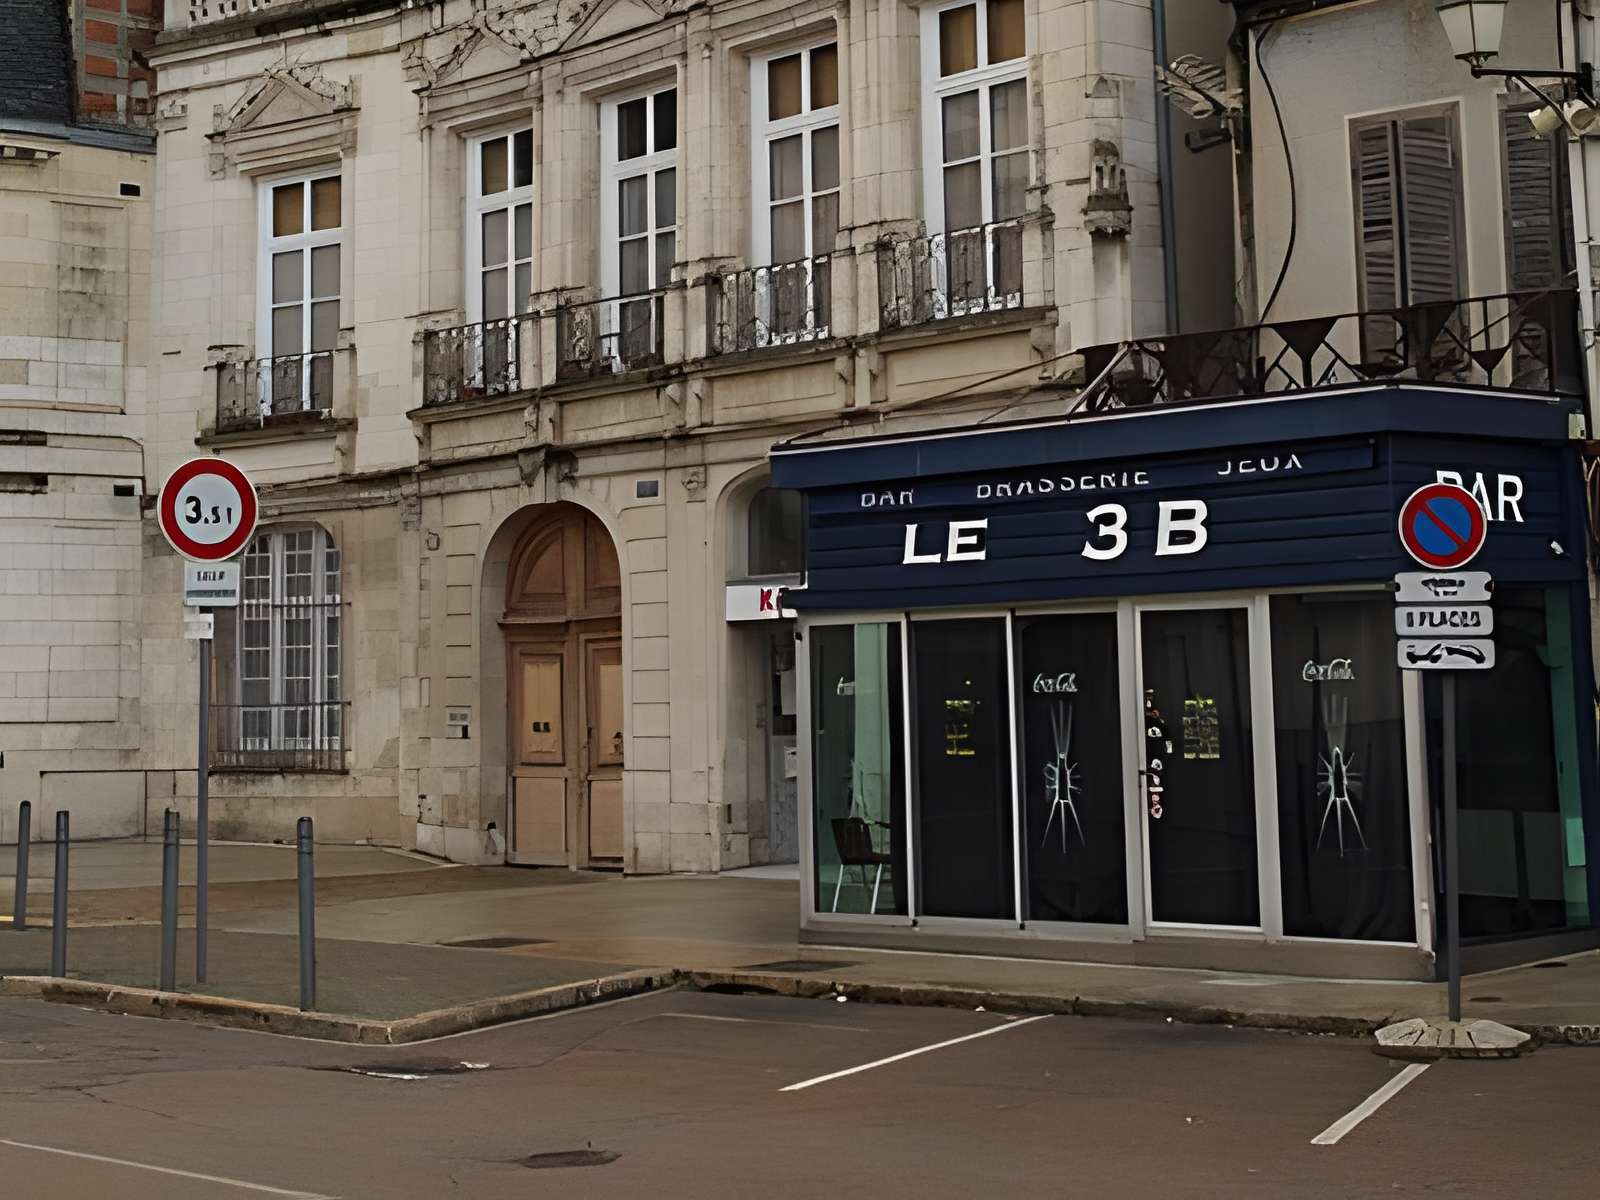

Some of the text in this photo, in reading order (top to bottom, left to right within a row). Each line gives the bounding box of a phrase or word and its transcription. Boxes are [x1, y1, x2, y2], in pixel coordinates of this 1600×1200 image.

[902, 499, 1208, 564] LE 3 B
